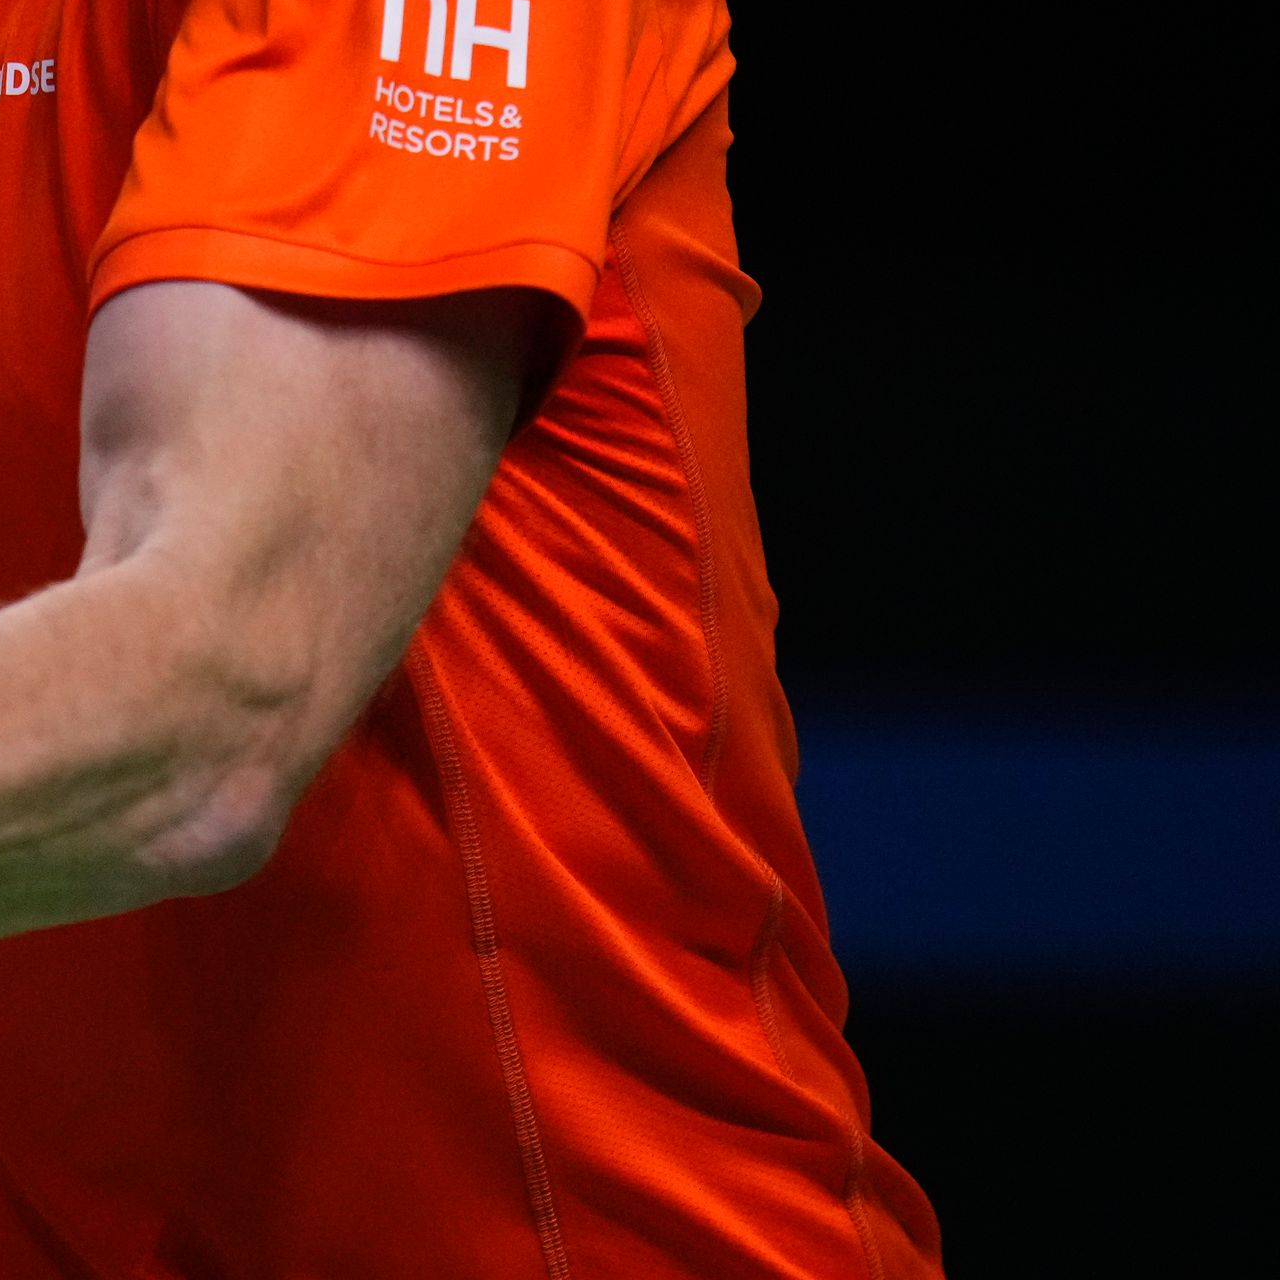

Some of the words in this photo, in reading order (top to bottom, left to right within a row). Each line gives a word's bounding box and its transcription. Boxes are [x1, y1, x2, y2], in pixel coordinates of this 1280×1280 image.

[374, 76, 494, 128] HOTELS
[498, 104, 522, 129] &
[369, 111, 520, 162] RESORTS
